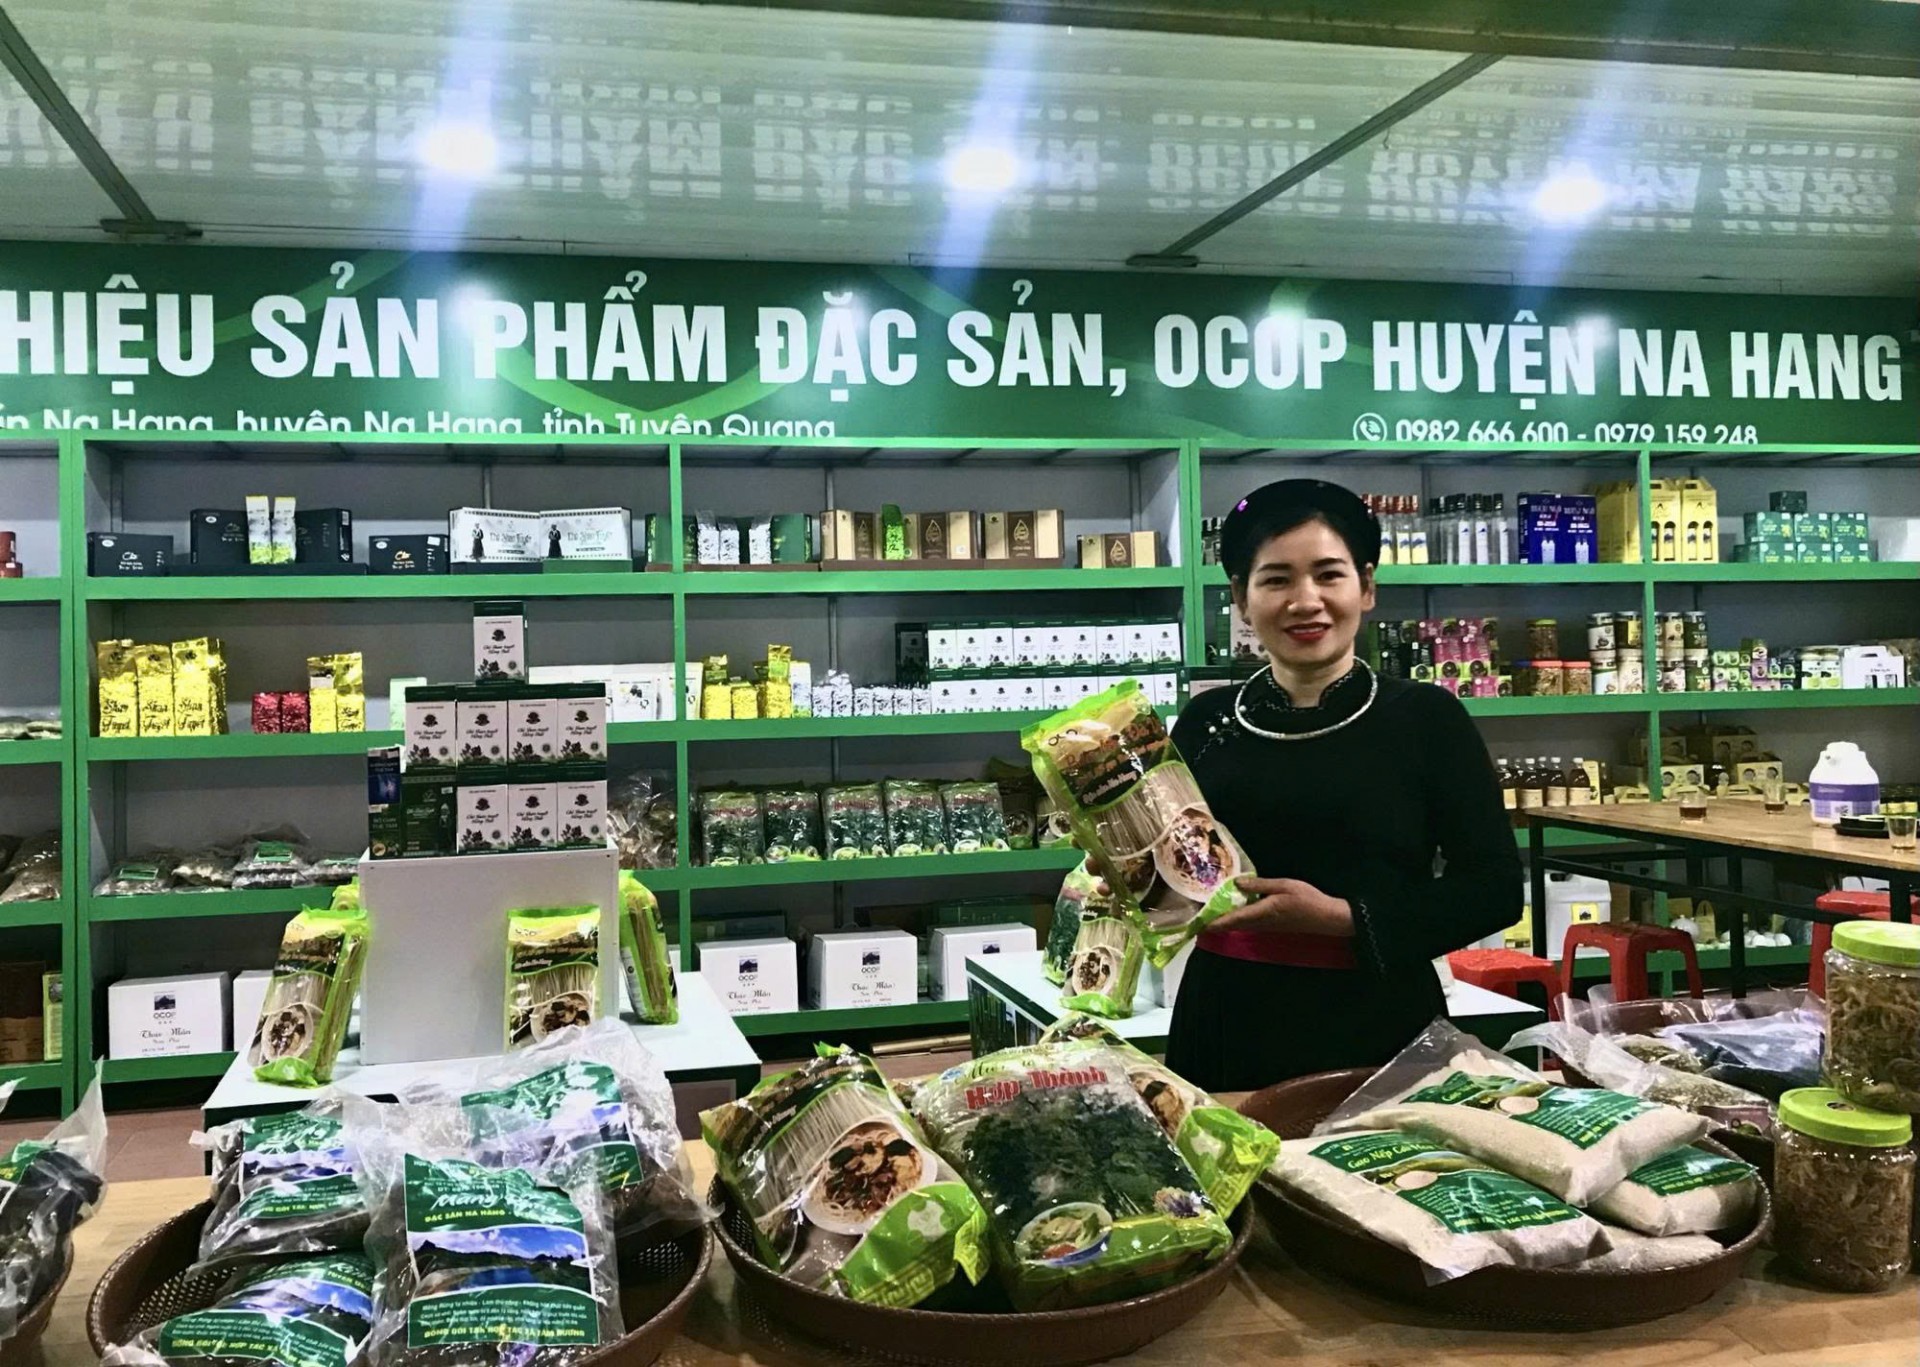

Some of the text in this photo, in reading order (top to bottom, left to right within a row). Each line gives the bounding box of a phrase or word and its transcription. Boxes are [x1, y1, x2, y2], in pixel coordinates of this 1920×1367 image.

[250, 261, 440, 378] SẢN
[472, 270, 728, 383] PHẨM
[755, 291, 917, 402] ĐẶC
[947, 279, 1127, 397] SẢN,
[1154, 314, 1347, 390] OCOP
[1372, 310, 1597, 409] HUYỆN
[1618, 328, 1710, 398] NA
[1730, 331, 1902, 401] HANG
[1396, 419, 1459, 442] 0982
[1468, 420, 1515, 442] 666
[1522, 421, 1568, 443] 600
[1595, 423, 1654, 443] 0979
[1665, 424, 1706, 444] 159
[1714, 425, 1758, 445] 248
